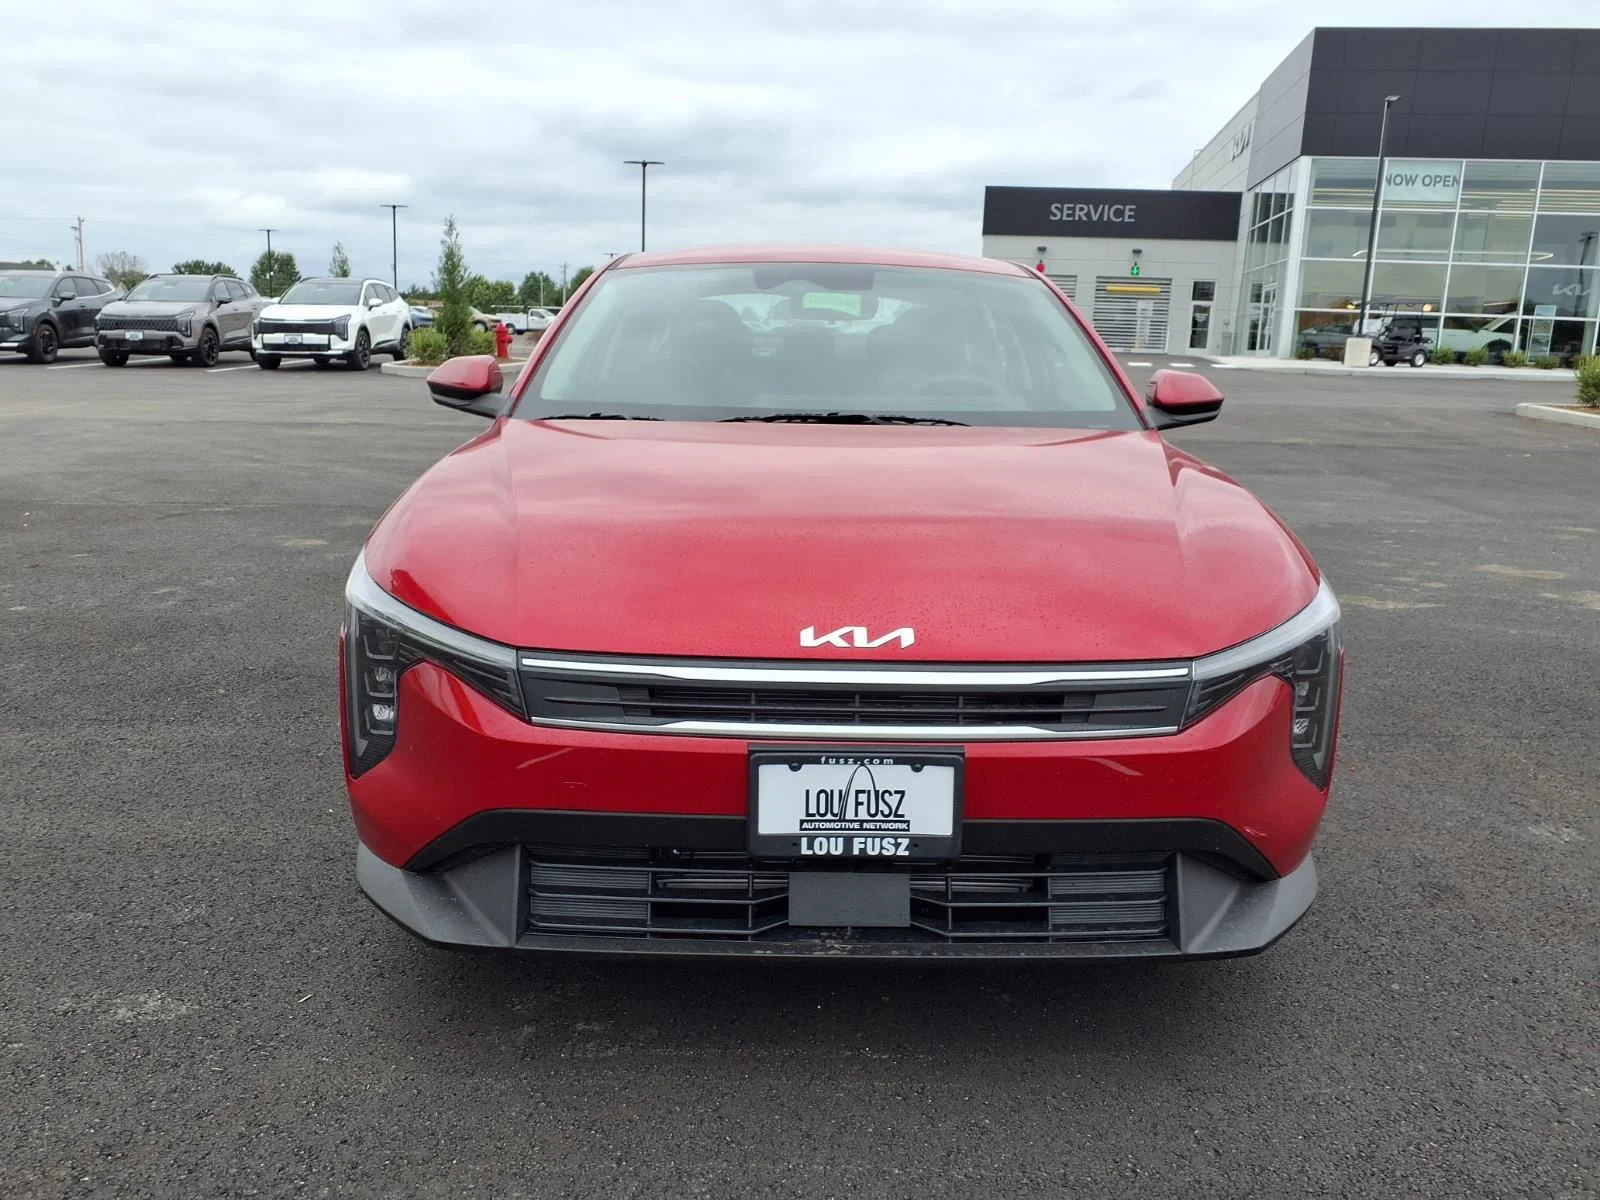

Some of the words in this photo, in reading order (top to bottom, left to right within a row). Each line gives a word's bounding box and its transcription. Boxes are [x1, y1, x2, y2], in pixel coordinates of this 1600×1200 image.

[1385, 173, 1418, 186] NOW
[1421, 174, 1460, 188] OPEN
[1049, 203, 1136, 222] SERVICE
[800, 626, 915, 648] KIA
[821, 756, 894, 765] fusz.com
[804, 789, 843, 818] LOU
[854, 789, 906, 818] FUSZ
[801, 821, 860, 829] AUTOMOTIVE
[863, 822, 909, 830] NETWORK
[801, 837, 843, 855] LOU
[852, 837, 910, 856] FUSZ
